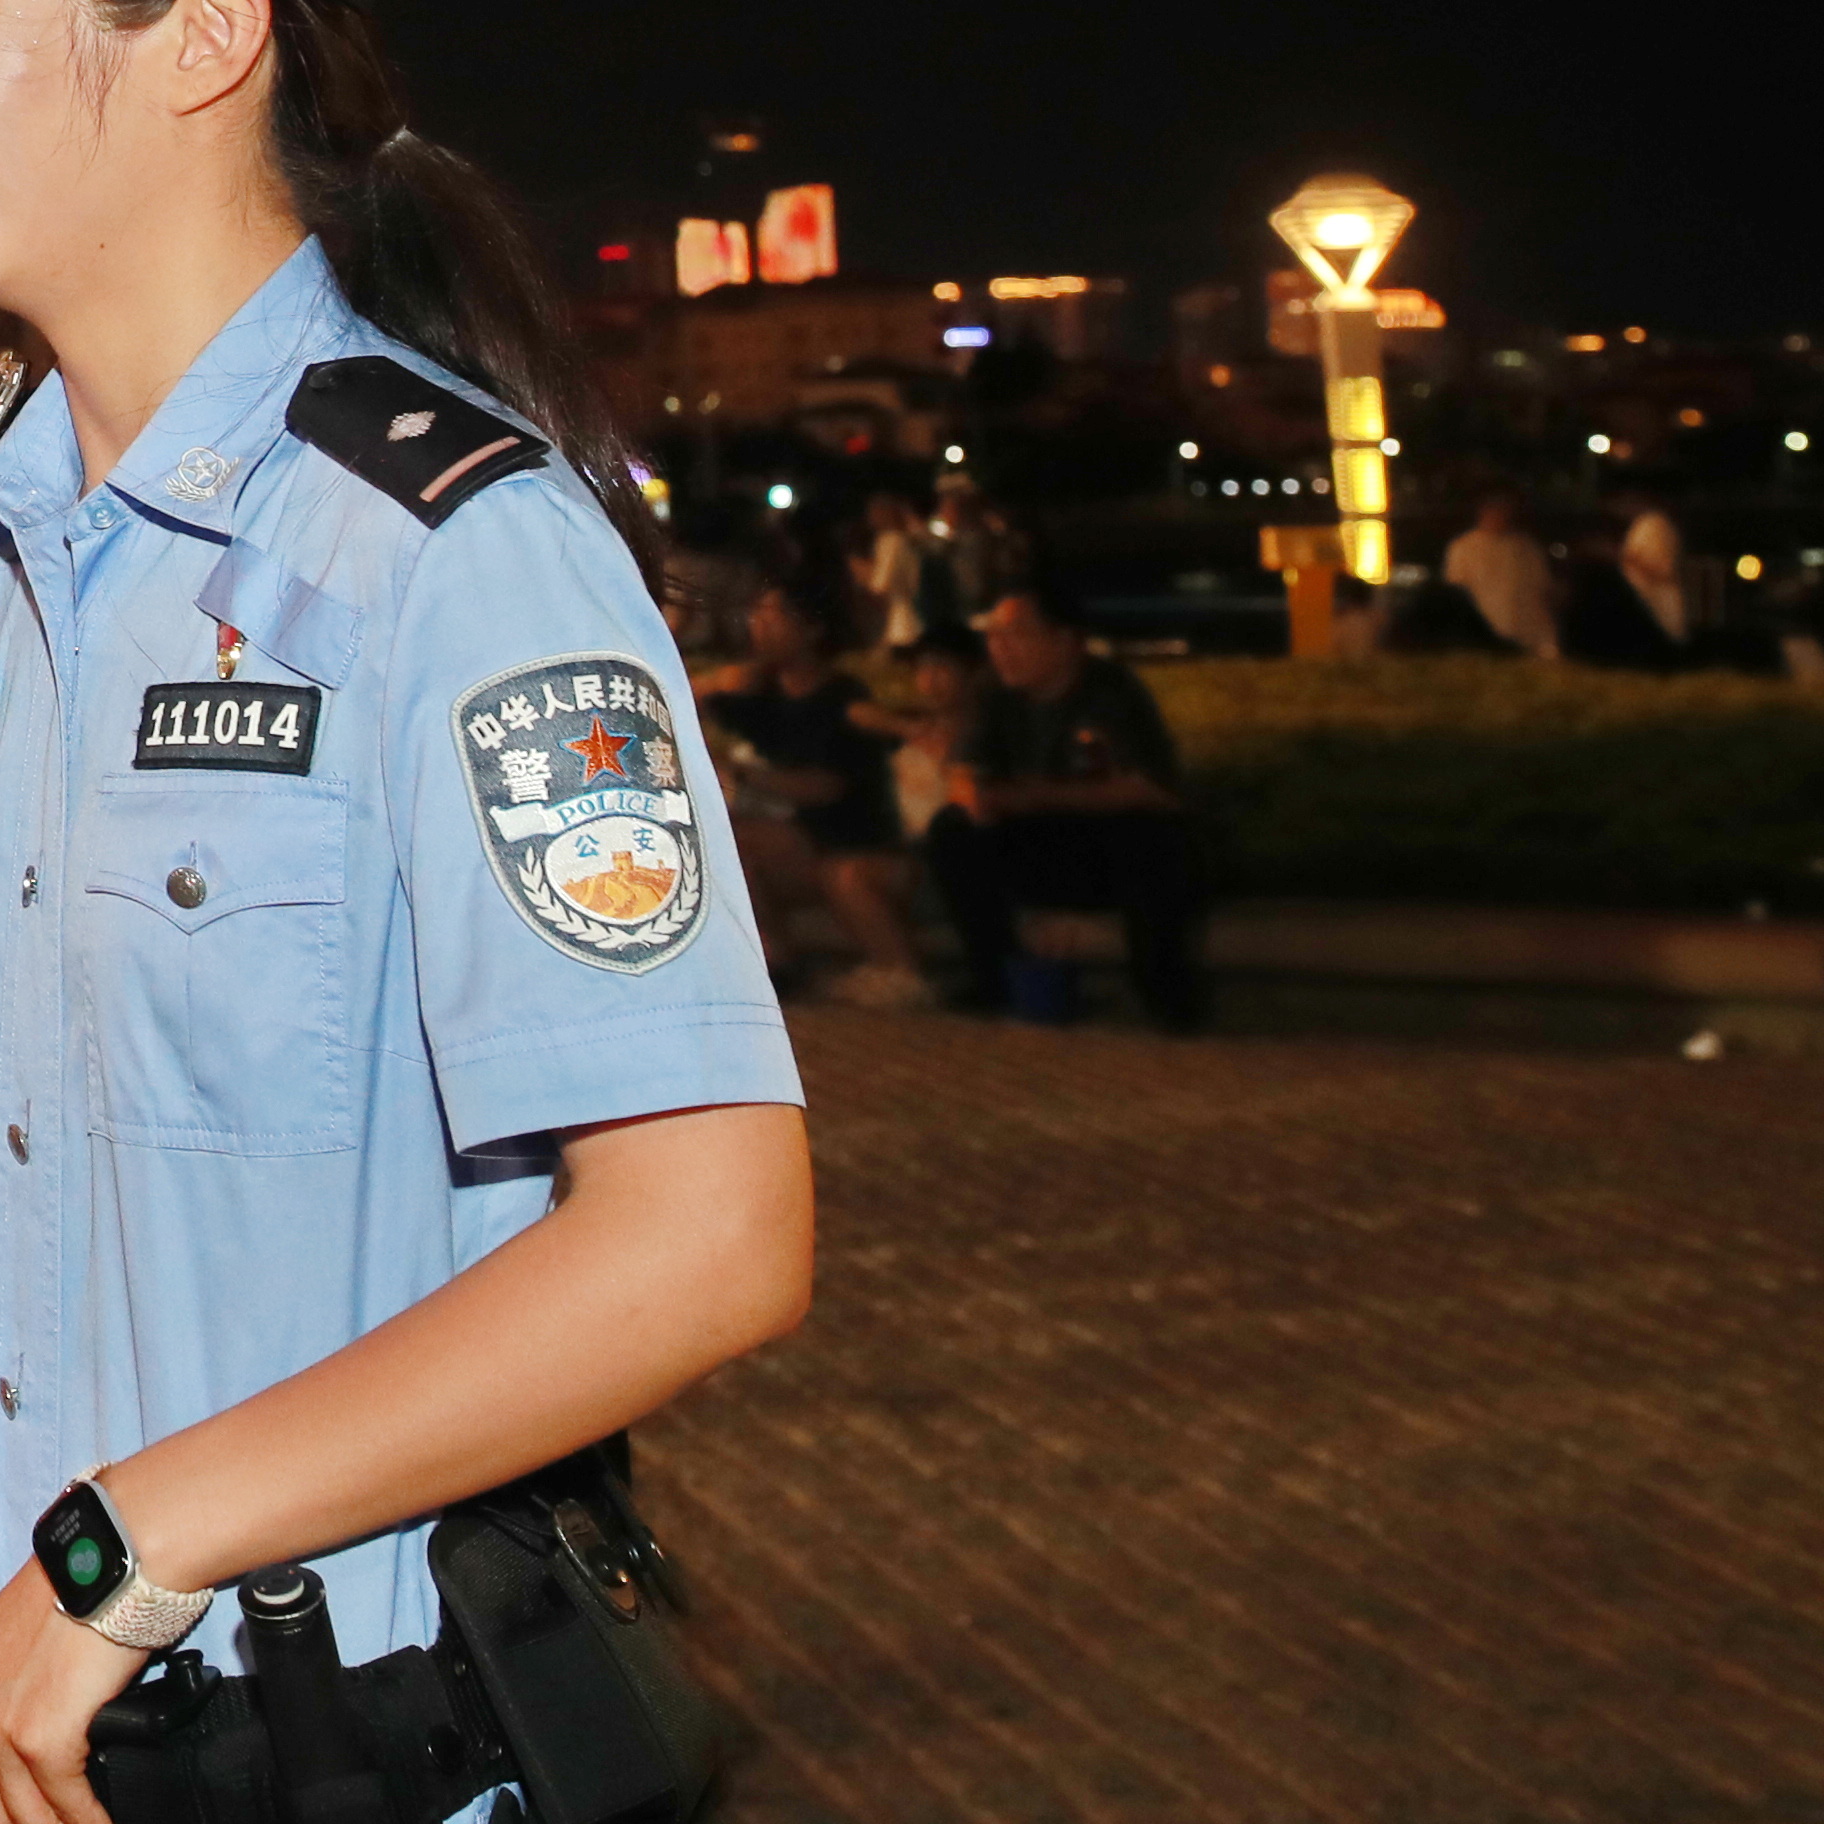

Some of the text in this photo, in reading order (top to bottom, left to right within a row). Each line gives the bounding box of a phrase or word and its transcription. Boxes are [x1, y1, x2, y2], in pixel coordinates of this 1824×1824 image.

[145, 700, 300, 750] 111014
[467, 674, 673, 751] 中华人民共和国
[556, 792, 658, 826] POLICE
